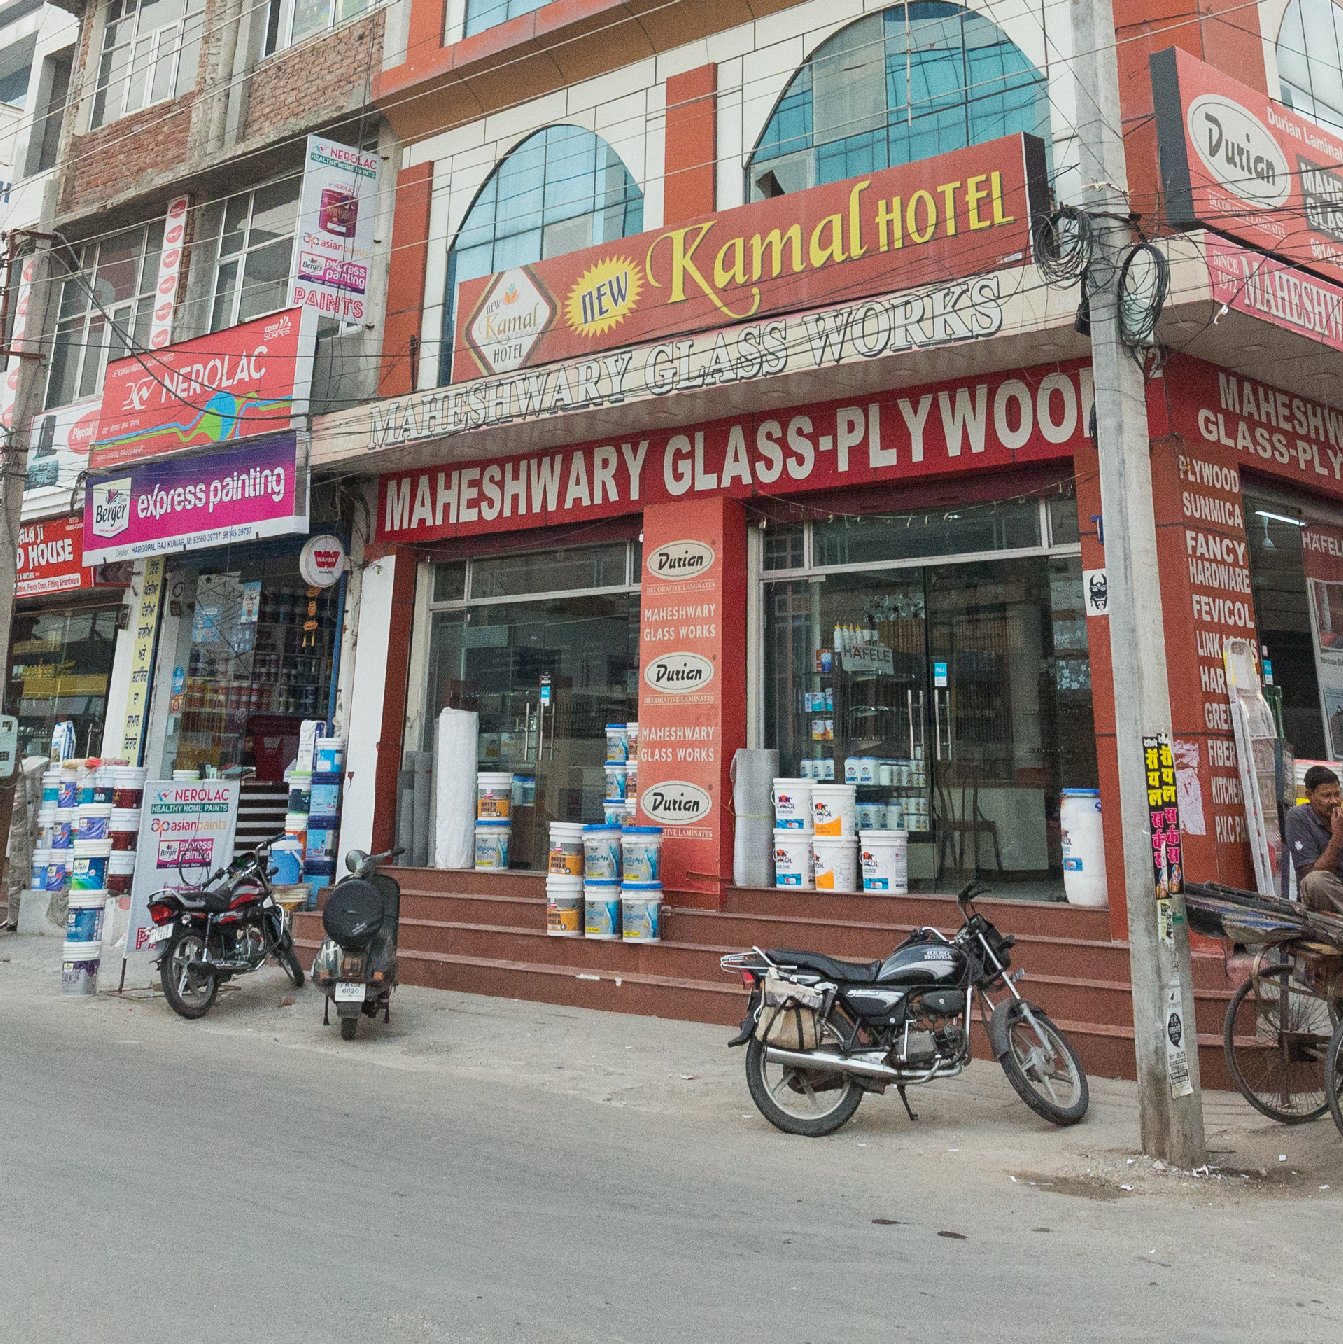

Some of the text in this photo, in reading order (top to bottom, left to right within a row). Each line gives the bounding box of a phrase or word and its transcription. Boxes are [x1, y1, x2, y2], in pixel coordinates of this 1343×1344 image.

[1267, 105, 1301, 140] Durian
[330, 147, 377, 170] NEROLAC
[1205, 112, 1276, 186] Durian
[646, 179, 871, 319] Kamal
[876, 171, 1015, 252] HOTEL
[326, 258, 366, 276] express
[1213, 250, 1240, 273] SINCE
[325, 269, 365, 289] painting
[293, 286, 364, 318] PAINTS
[479, 303, 540, 346] Kamal
[367, 276, 1003, 449] MAHESHWARY GLASS WORKS
[494, 343, 523, 364] HOTEL
[161, 346, 268, 403] NEROLAC
[1178, 455, 1240, 493] PLYWOOD
[137, 465, 285, 520] express painting
[384, 441, 650, 532] MAHESHWARY
[95, 503, 127, 528] Berger
[1182, 491, 1244, 529] SUNMICA
[28, 538, 74, 570] HOUSE
[131, 544, 157, 555] HARGOPAL
[1185, 529, 1246, 565] FANCY
[658, 550, 703, 570] Durian
[1188, 557, 1252, 594] HARDWARE
[644, 604, 716, 622] MAHESHWARY
[1191, 594, 1255, 629] FEVICOL
[644, 623, 716, 641] GLASS WORKS
[1197, 630, 1222, 658] LINK
[656, 662, 702, 683] Durian
[642, 726, 715, 742] MAHESHWARY
[641, 747, 715, 763] GLASS WORKS
[174, 788, 230, 802] NEROLAC
[652, 792, 700, 813] Durian
[151, 803, 228, 814] HEALTHY HOME PAINTS
[159, 848, 178, 861] Berger
[179, 840, 212, 852] express
